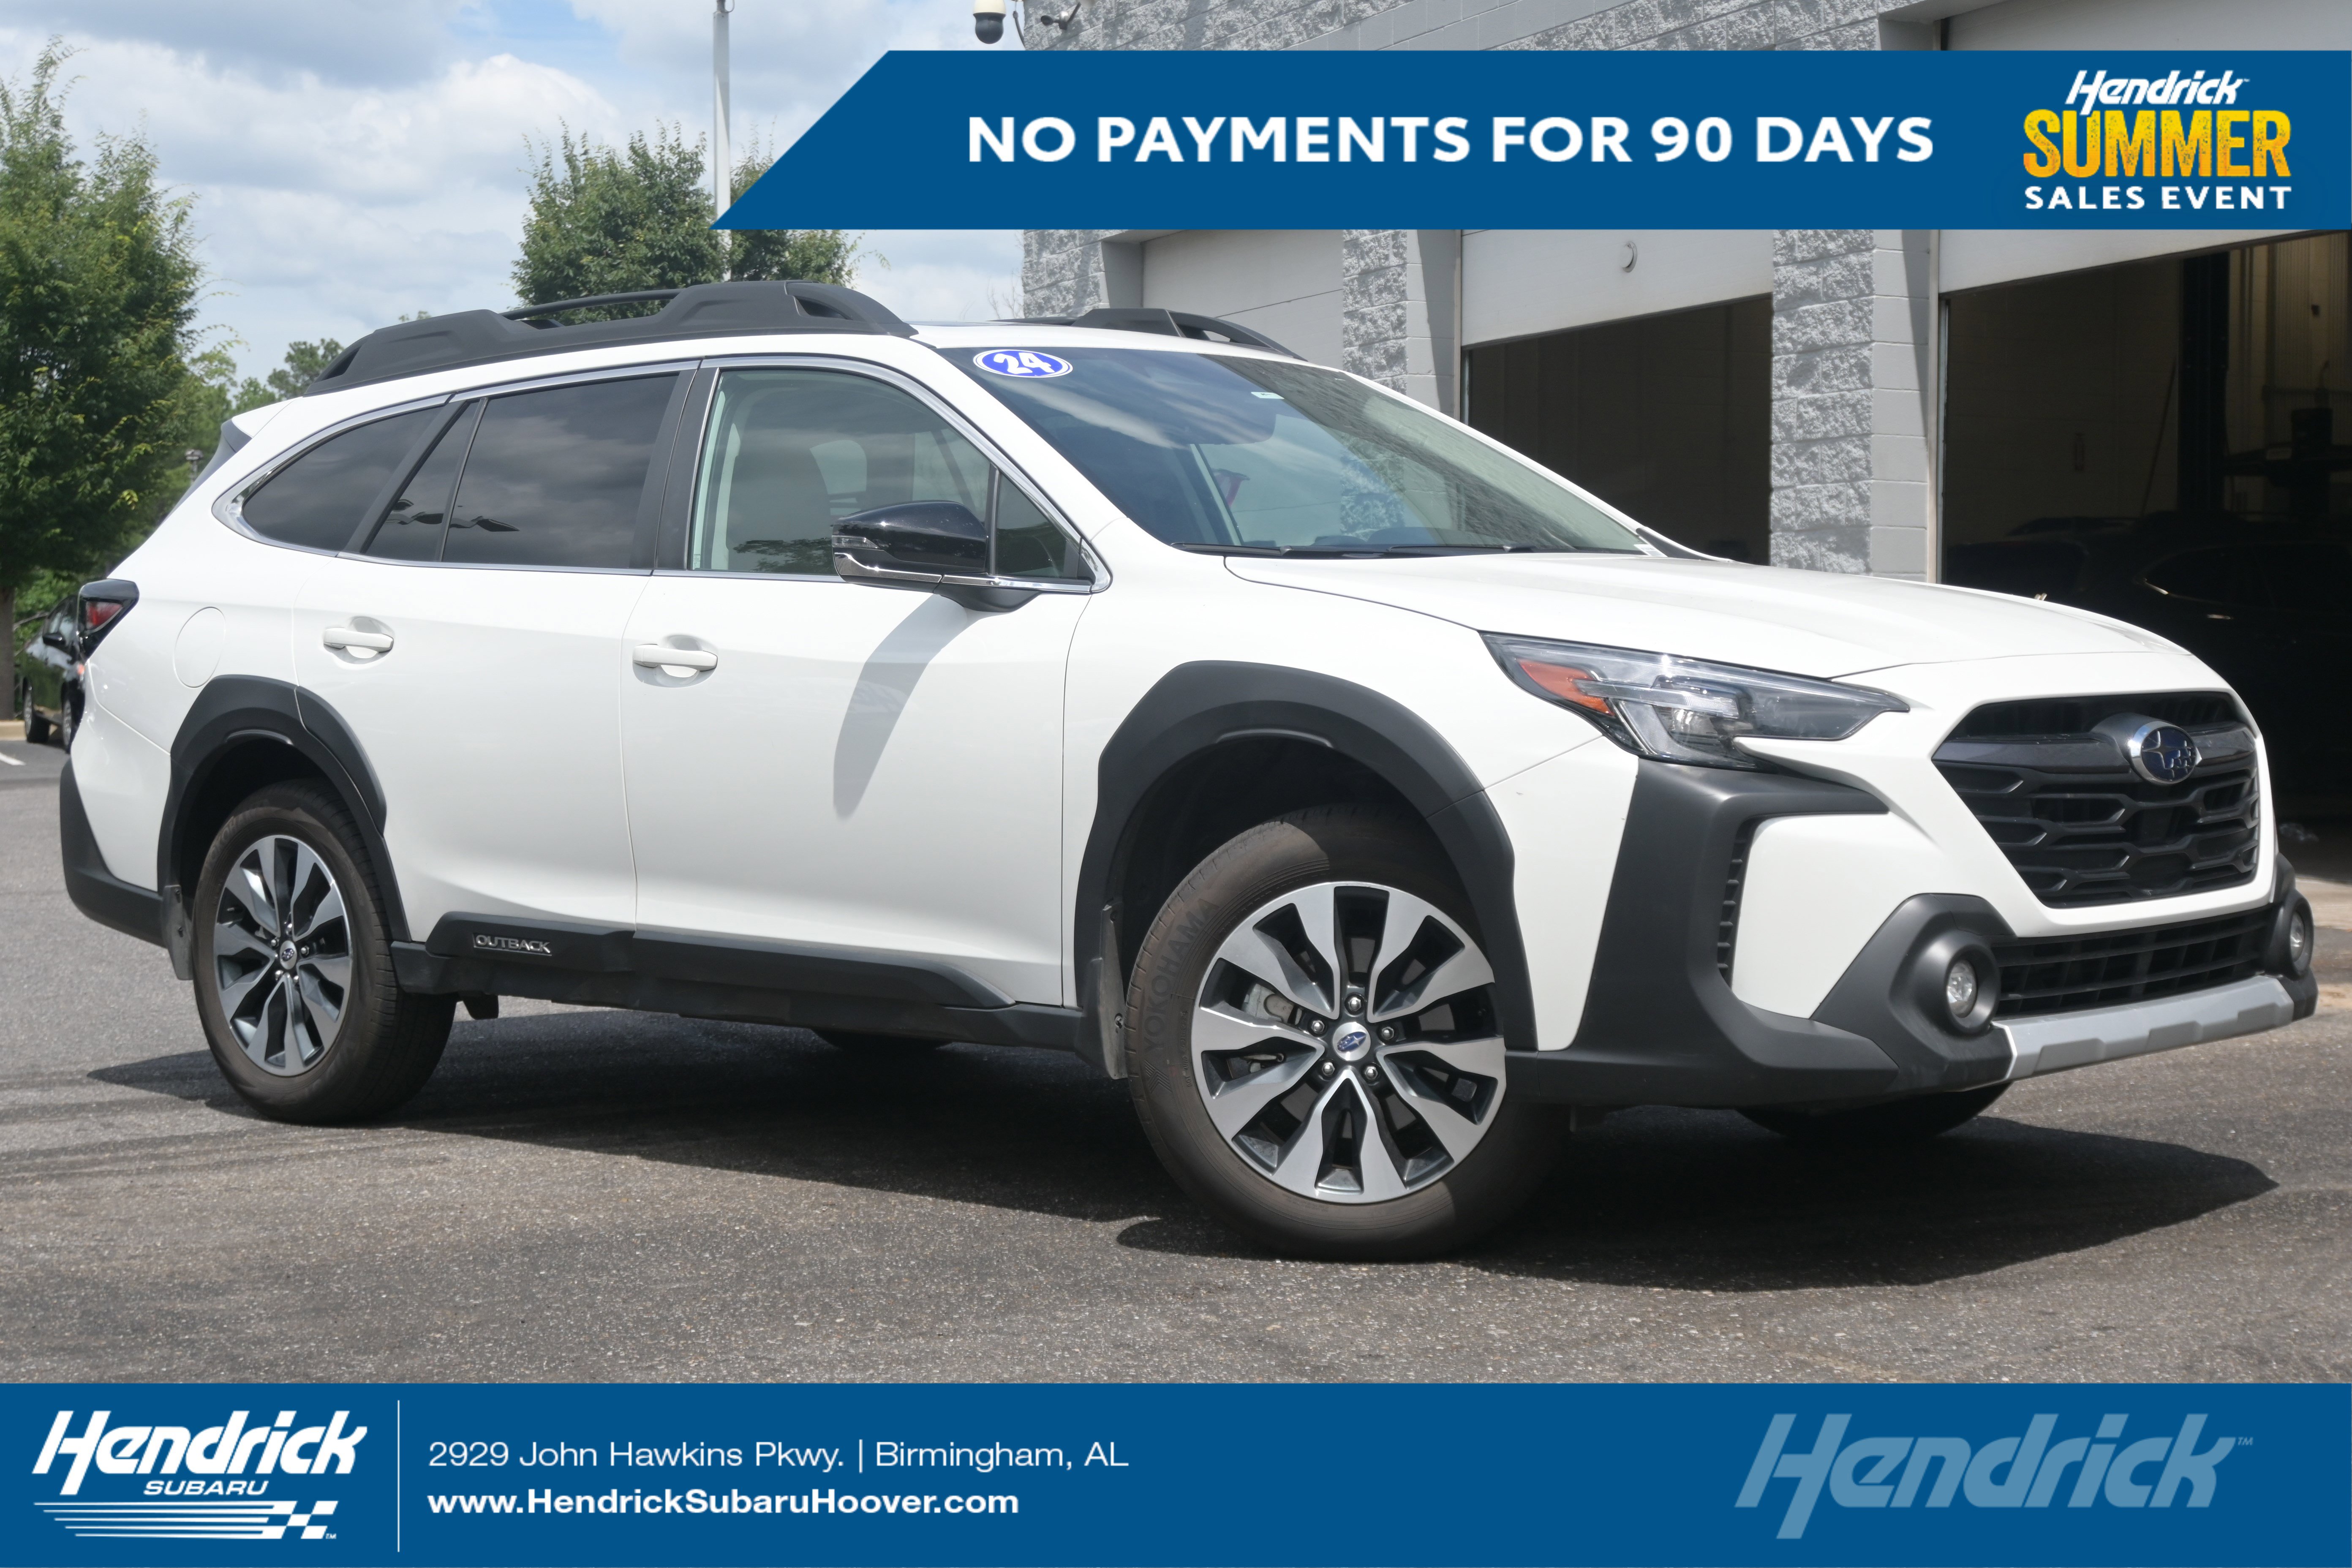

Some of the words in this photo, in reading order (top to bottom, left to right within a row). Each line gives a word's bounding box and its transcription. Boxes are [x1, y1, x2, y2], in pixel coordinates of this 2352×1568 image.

[993, 352, 1055, 374] 24
[476, 934, 551, 953] OUTBACK
[1144, 898, 1220, 1053] YOKOHAMA
